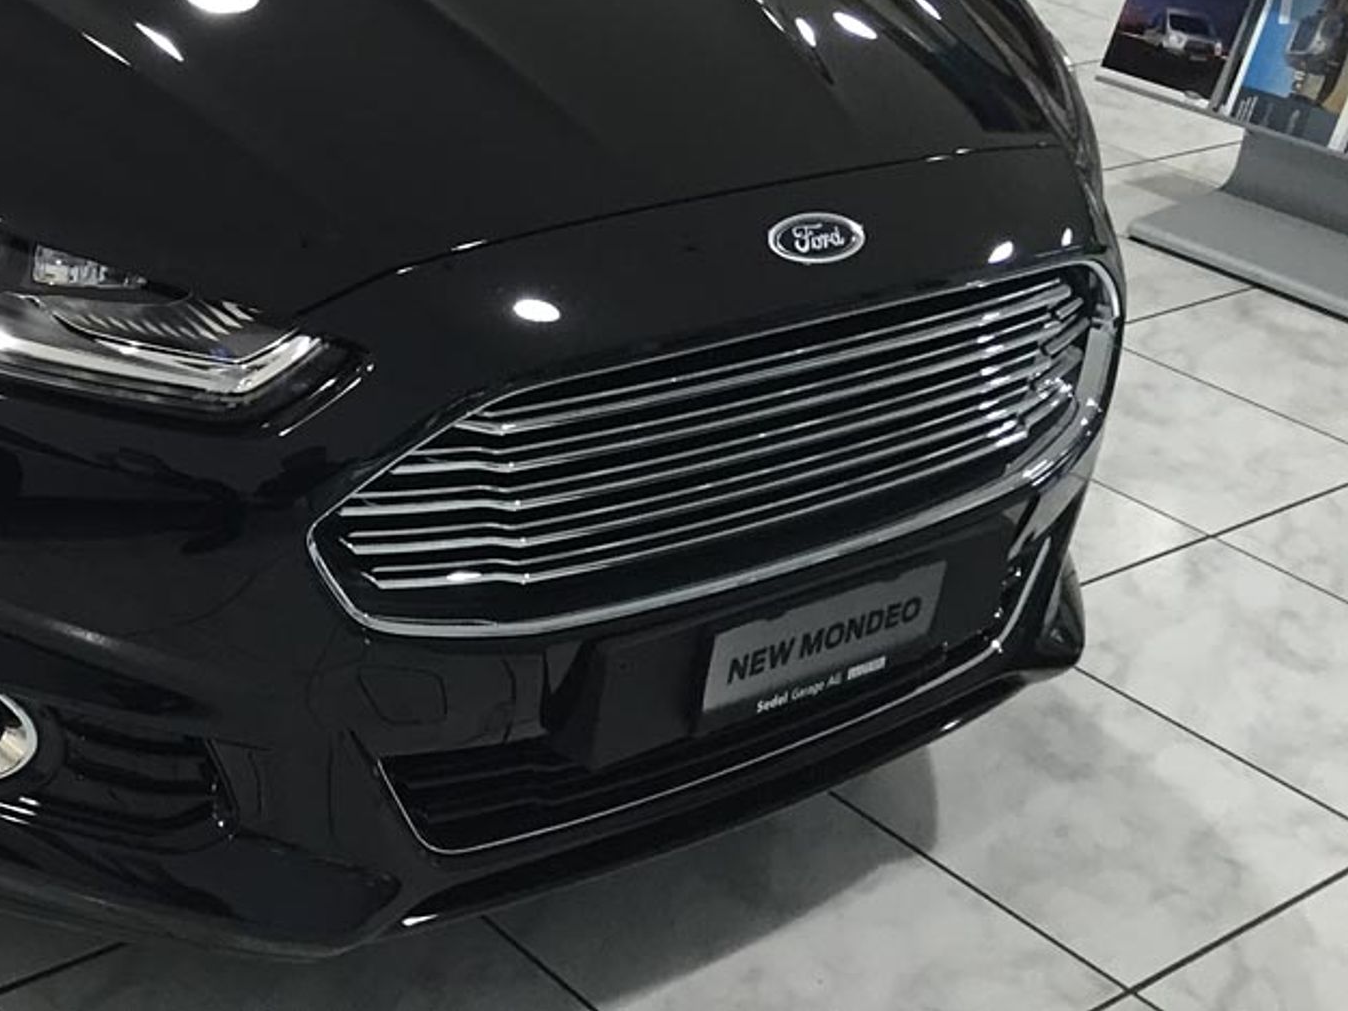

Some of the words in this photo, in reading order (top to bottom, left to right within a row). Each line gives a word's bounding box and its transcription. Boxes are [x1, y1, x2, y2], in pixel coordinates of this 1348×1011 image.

[791, 223, 845, 253] Ford
[726, 636, 795, 685] NEW
[798, 596, 922, 659] MONDEO
